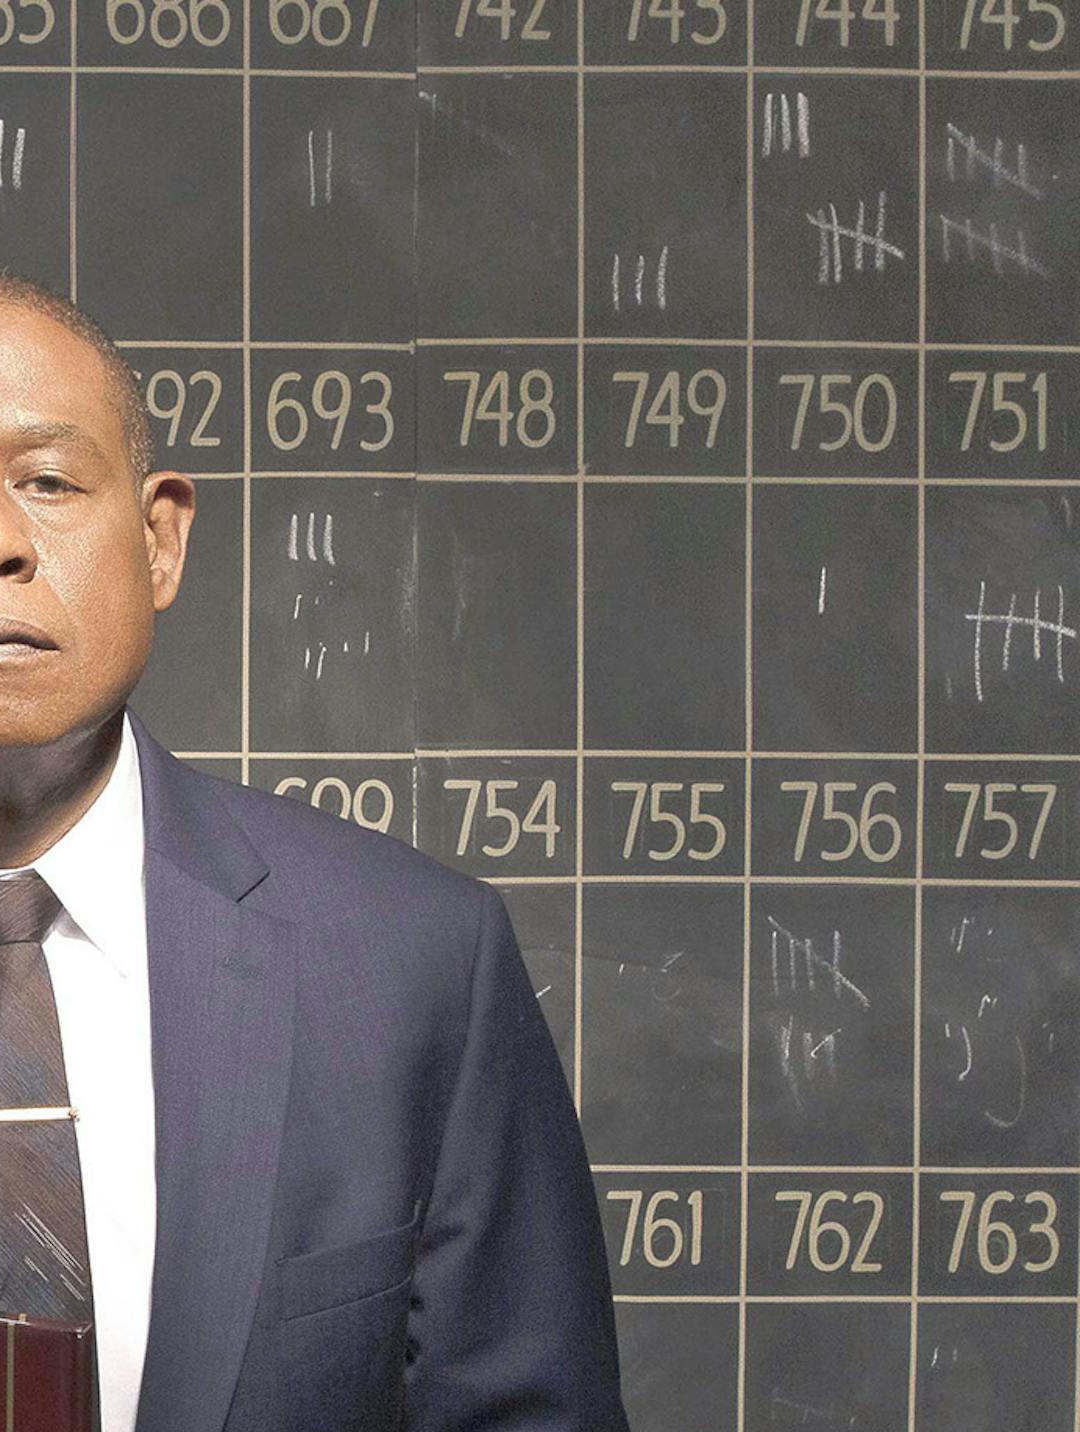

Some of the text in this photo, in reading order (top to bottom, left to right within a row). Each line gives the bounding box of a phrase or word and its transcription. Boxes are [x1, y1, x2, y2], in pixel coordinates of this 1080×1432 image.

[134, 370, 222, 447] 92
[267, 370, 394, 452] 693
[443, 369, 556, 448] 748
[612, 369, 727, 449] 749
[779, 373, 897, 452] 750
[948, 371, 1047, 453] 751
[443, 779, 561, 858] 754
[610, 781, 726, 861] 755
[780, 781, 902, 863] 756
[944, 782, 1057, 860] 757
[606, 1190, 703, 1268] 761
[775, 1190, 884, 1272] 762
[939, 1190, 1060, 1274] 763
